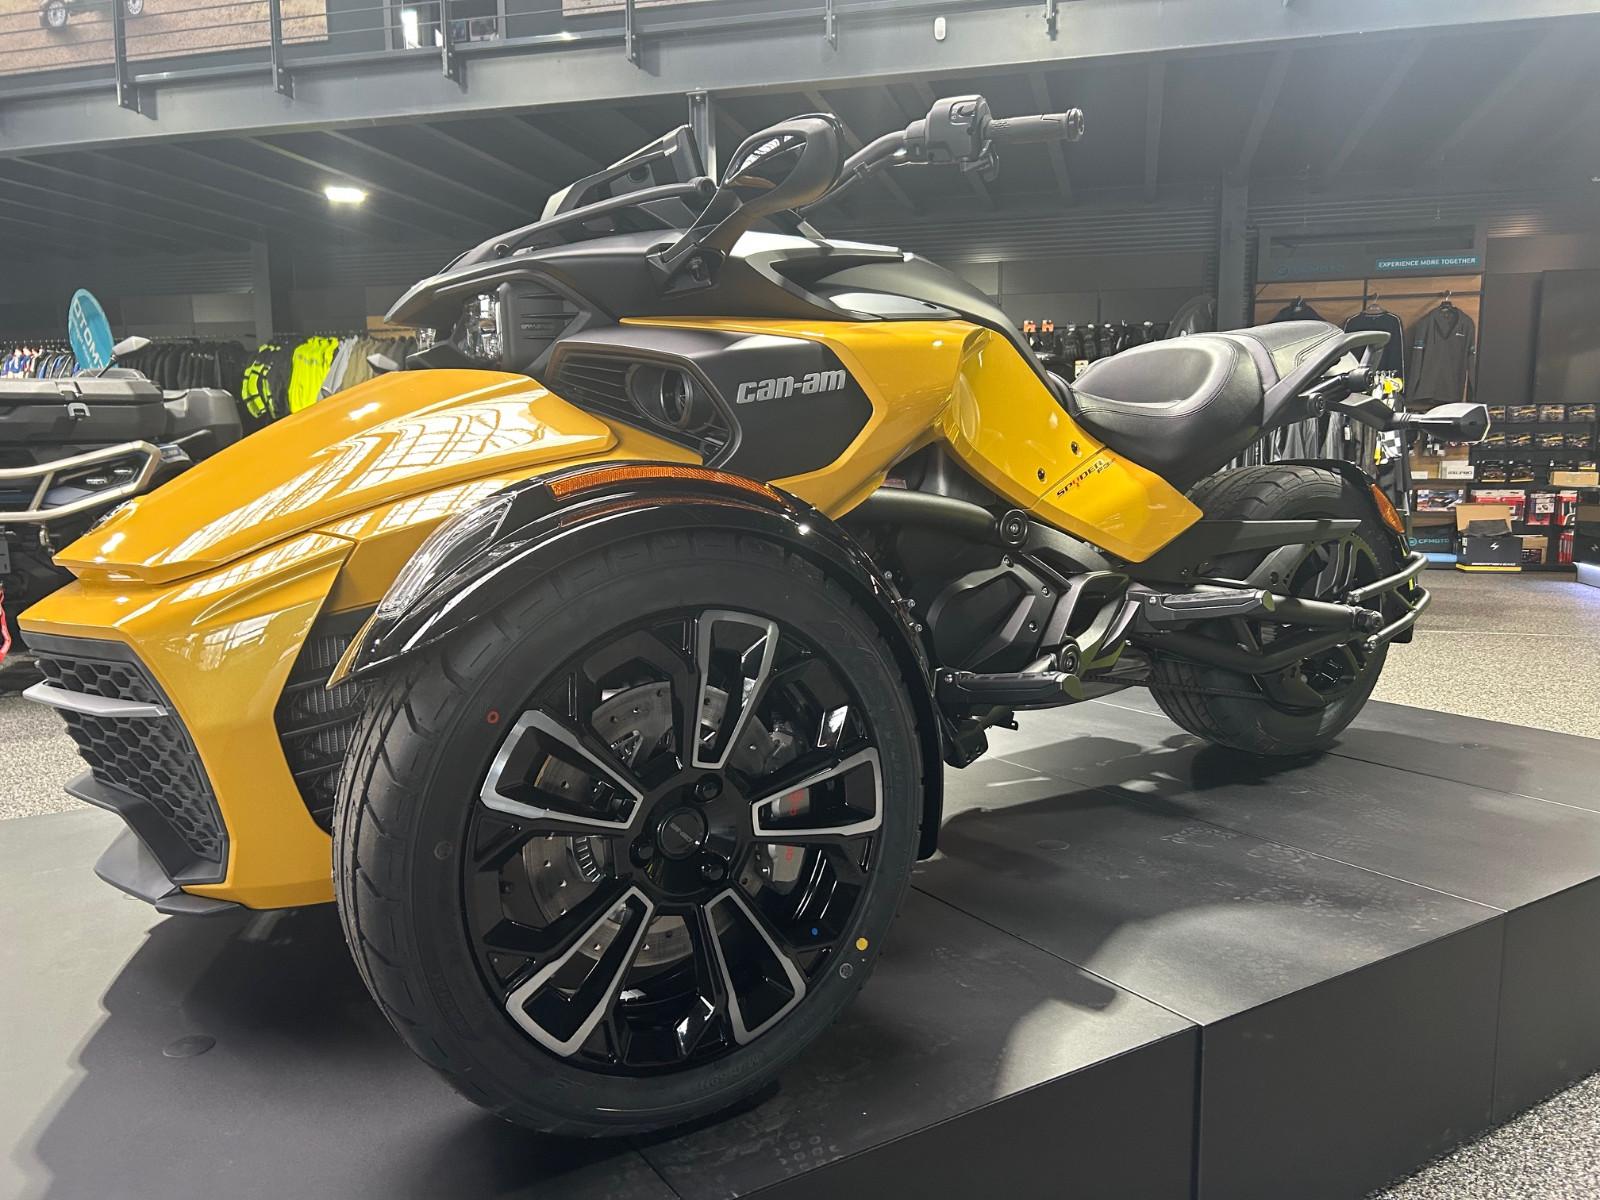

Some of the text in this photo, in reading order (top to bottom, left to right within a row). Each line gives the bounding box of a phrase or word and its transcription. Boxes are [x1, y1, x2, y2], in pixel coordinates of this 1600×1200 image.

[1378, 260, 1418, 268] EXPERIENCE
[1441, 257, 1476, 265] TOGETHER
[736, 369, 846, 404] can-am
